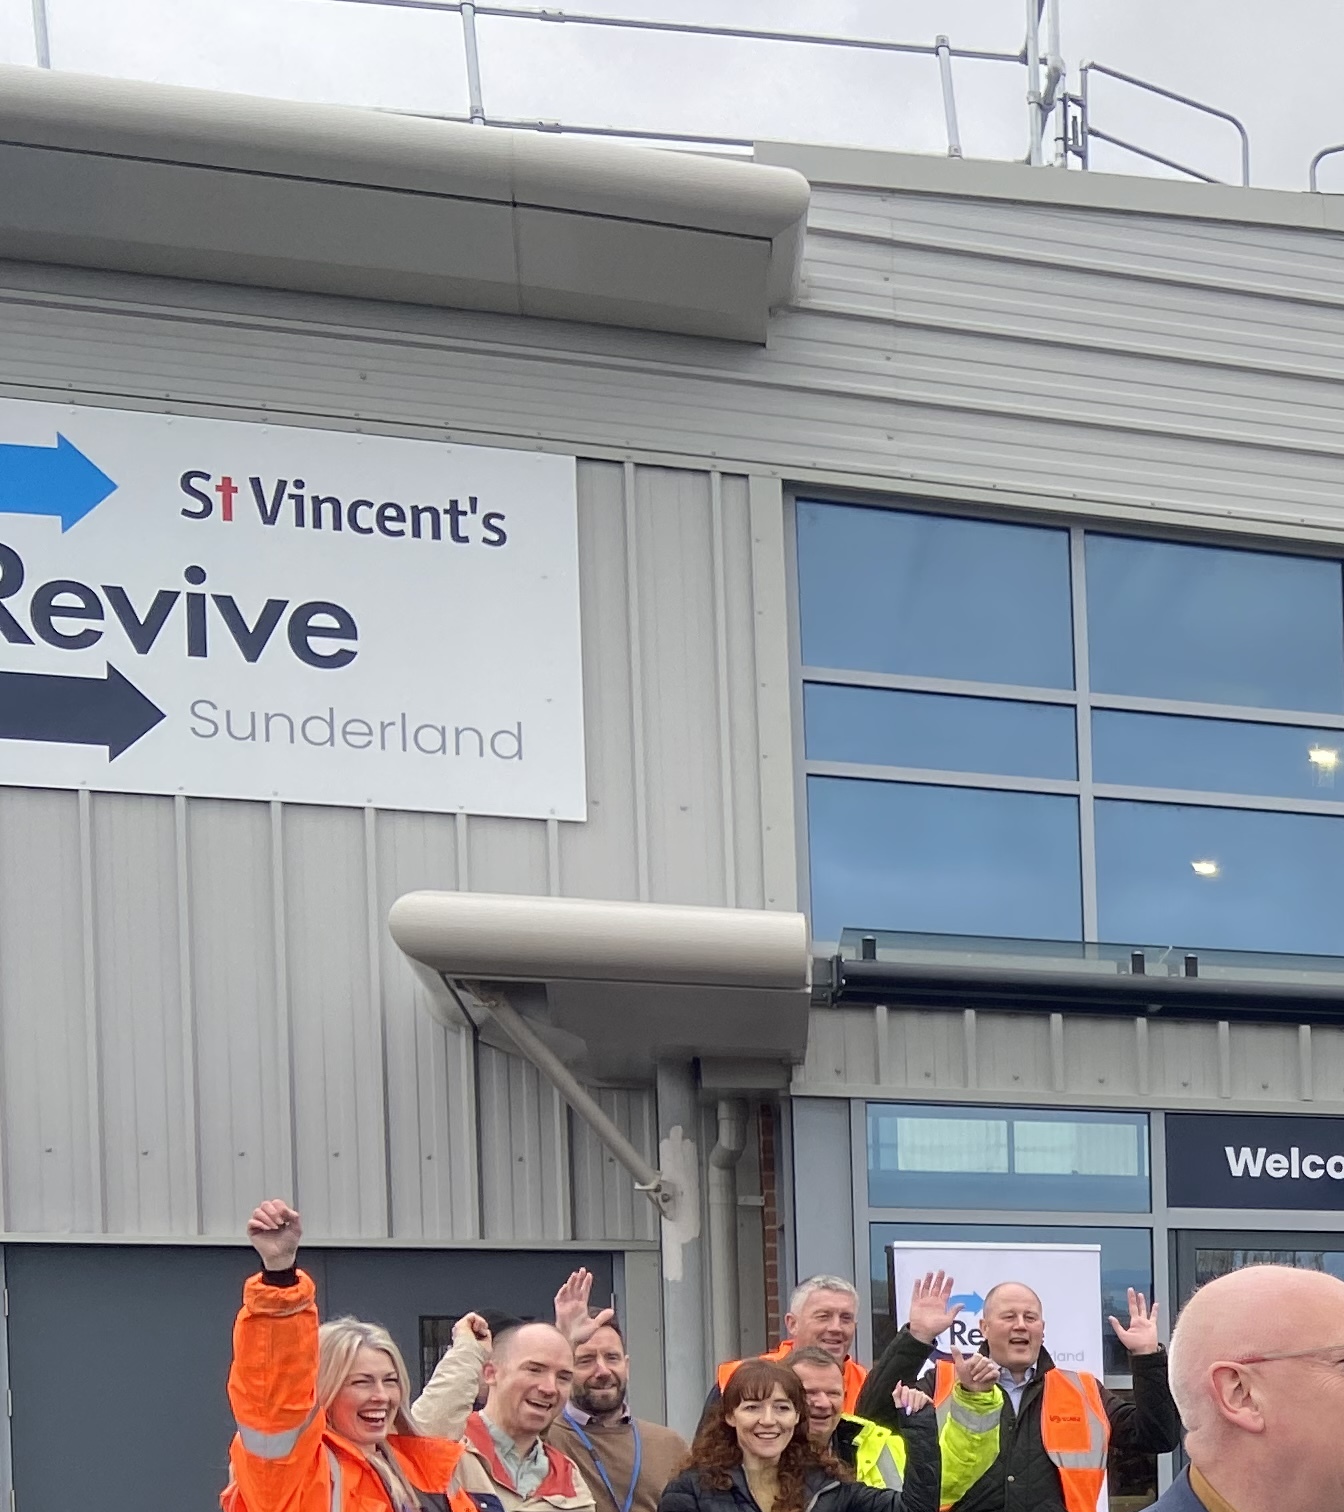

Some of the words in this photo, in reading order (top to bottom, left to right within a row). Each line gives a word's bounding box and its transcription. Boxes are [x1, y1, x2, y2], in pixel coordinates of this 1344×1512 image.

[181, 471, 238, 521] St
[249, 477, 507, 547] Vincent's
[190, 700, 523, 760] Sunderland
